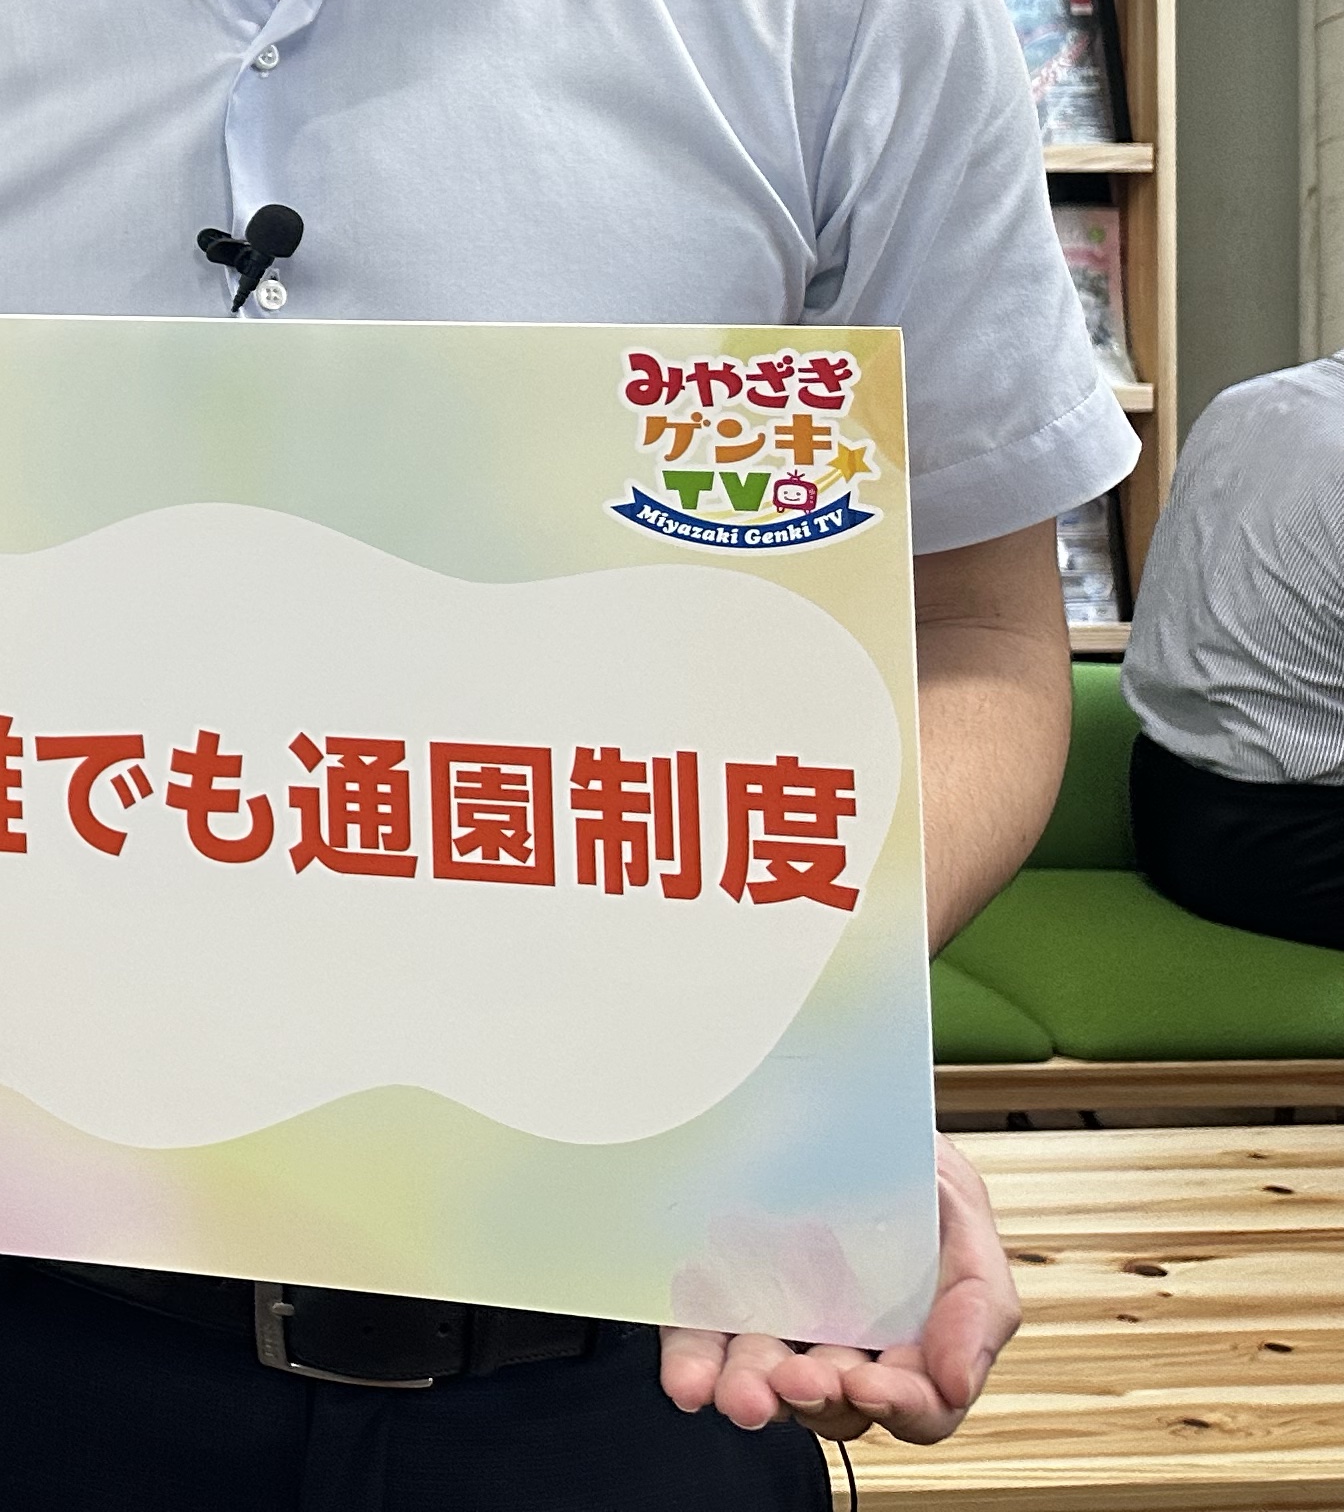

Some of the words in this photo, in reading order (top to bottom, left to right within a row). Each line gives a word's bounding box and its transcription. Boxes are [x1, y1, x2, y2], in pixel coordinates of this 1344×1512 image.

[624, 352, 854, 410] みやざき
[643, 411, 832, 466] ゲンキ
[662, 469, 772, 512] TV
[636, 504, 739, 545] Miyazaki
[744, 520, 812, 545] Genki
[814, 508, 846, 534] TV
